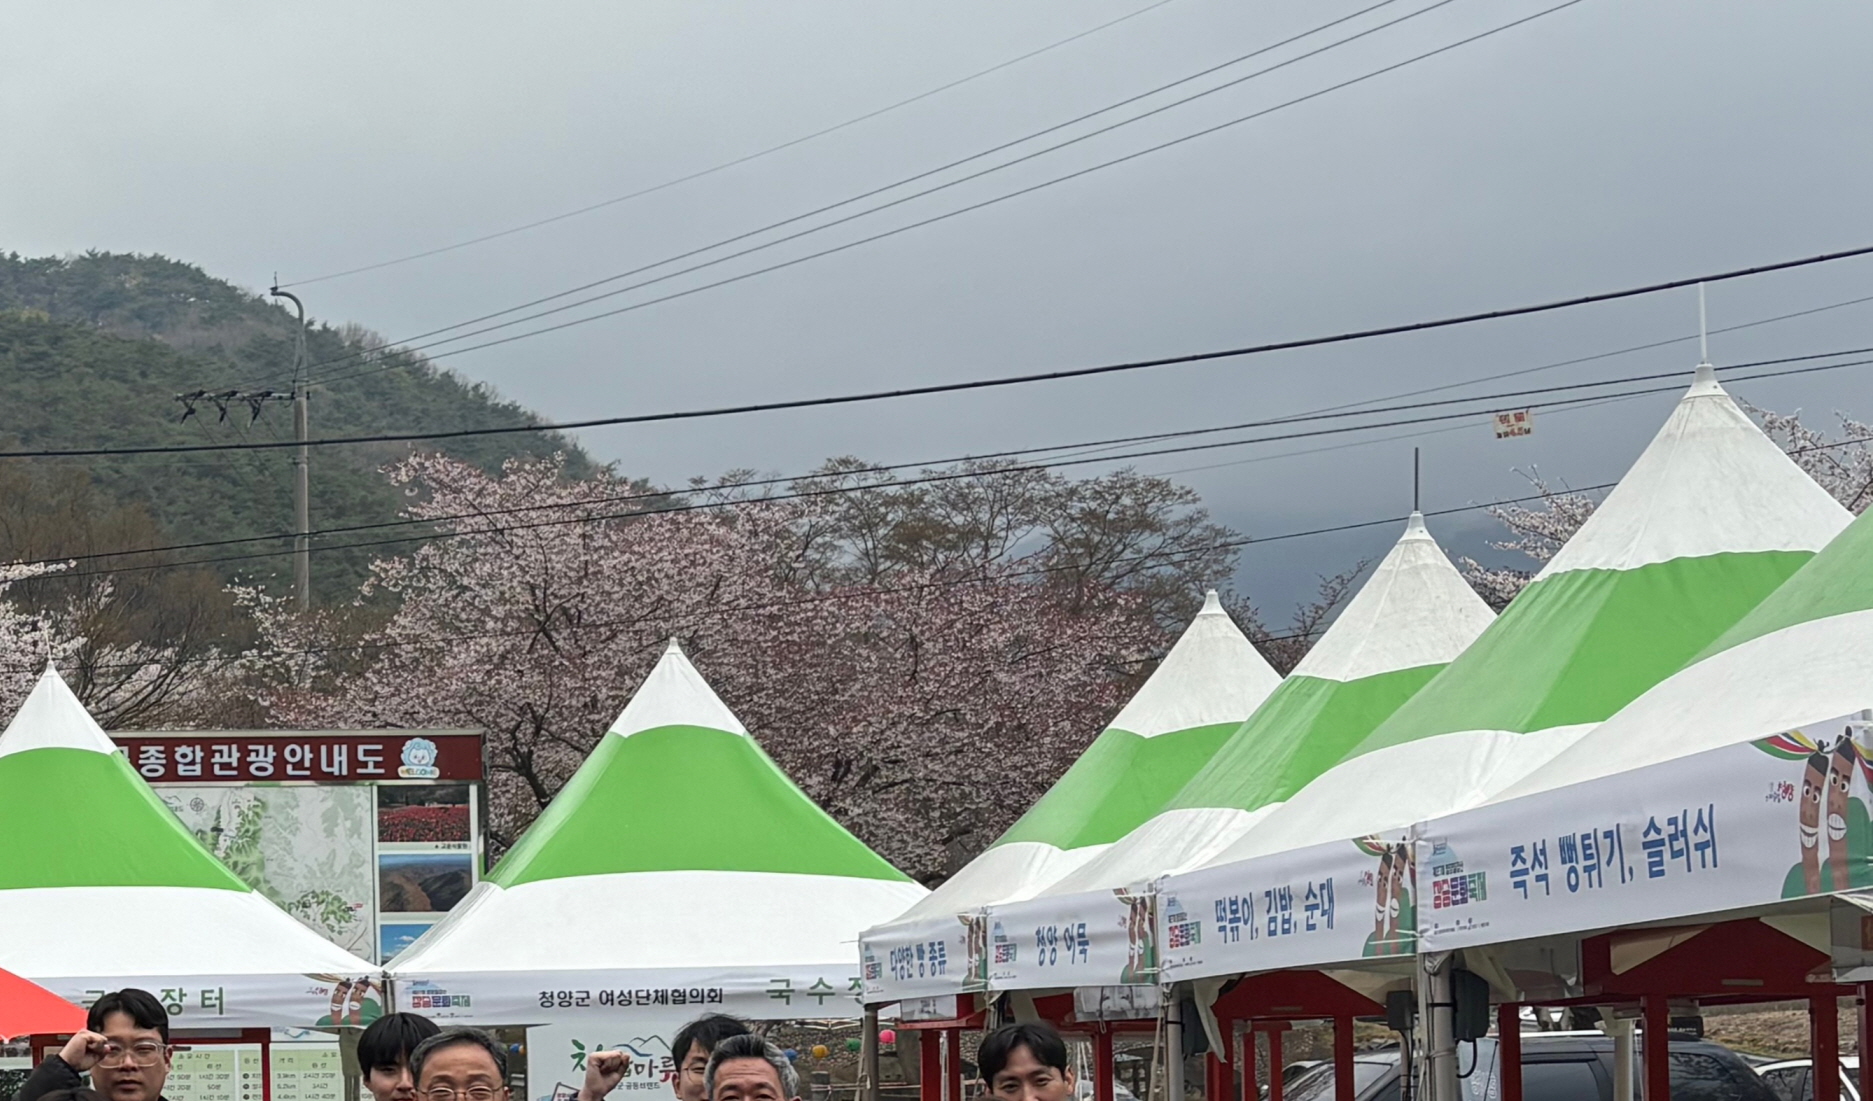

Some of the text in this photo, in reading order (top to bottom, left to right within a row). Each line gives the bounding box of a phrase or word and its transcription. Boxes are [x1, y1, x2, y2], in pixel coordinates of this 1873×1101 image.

[127, 744, 386, 778] 종합관광안내도
[1509, 803, 1718, 900] 즉석 뻥튀기, 슬러쉬
[1215, 877, 1335, 944] 떡볶이, 김밥, 순대
[890, 943, 914, 981] 다양한
[928, 940, 948, 977] 종류
[1035, 926, 1058, 967] 청양
[1063, 922, 1090, 965] 어묵
[539, 987, 725, 1009] 청양군 여성단체협의회
